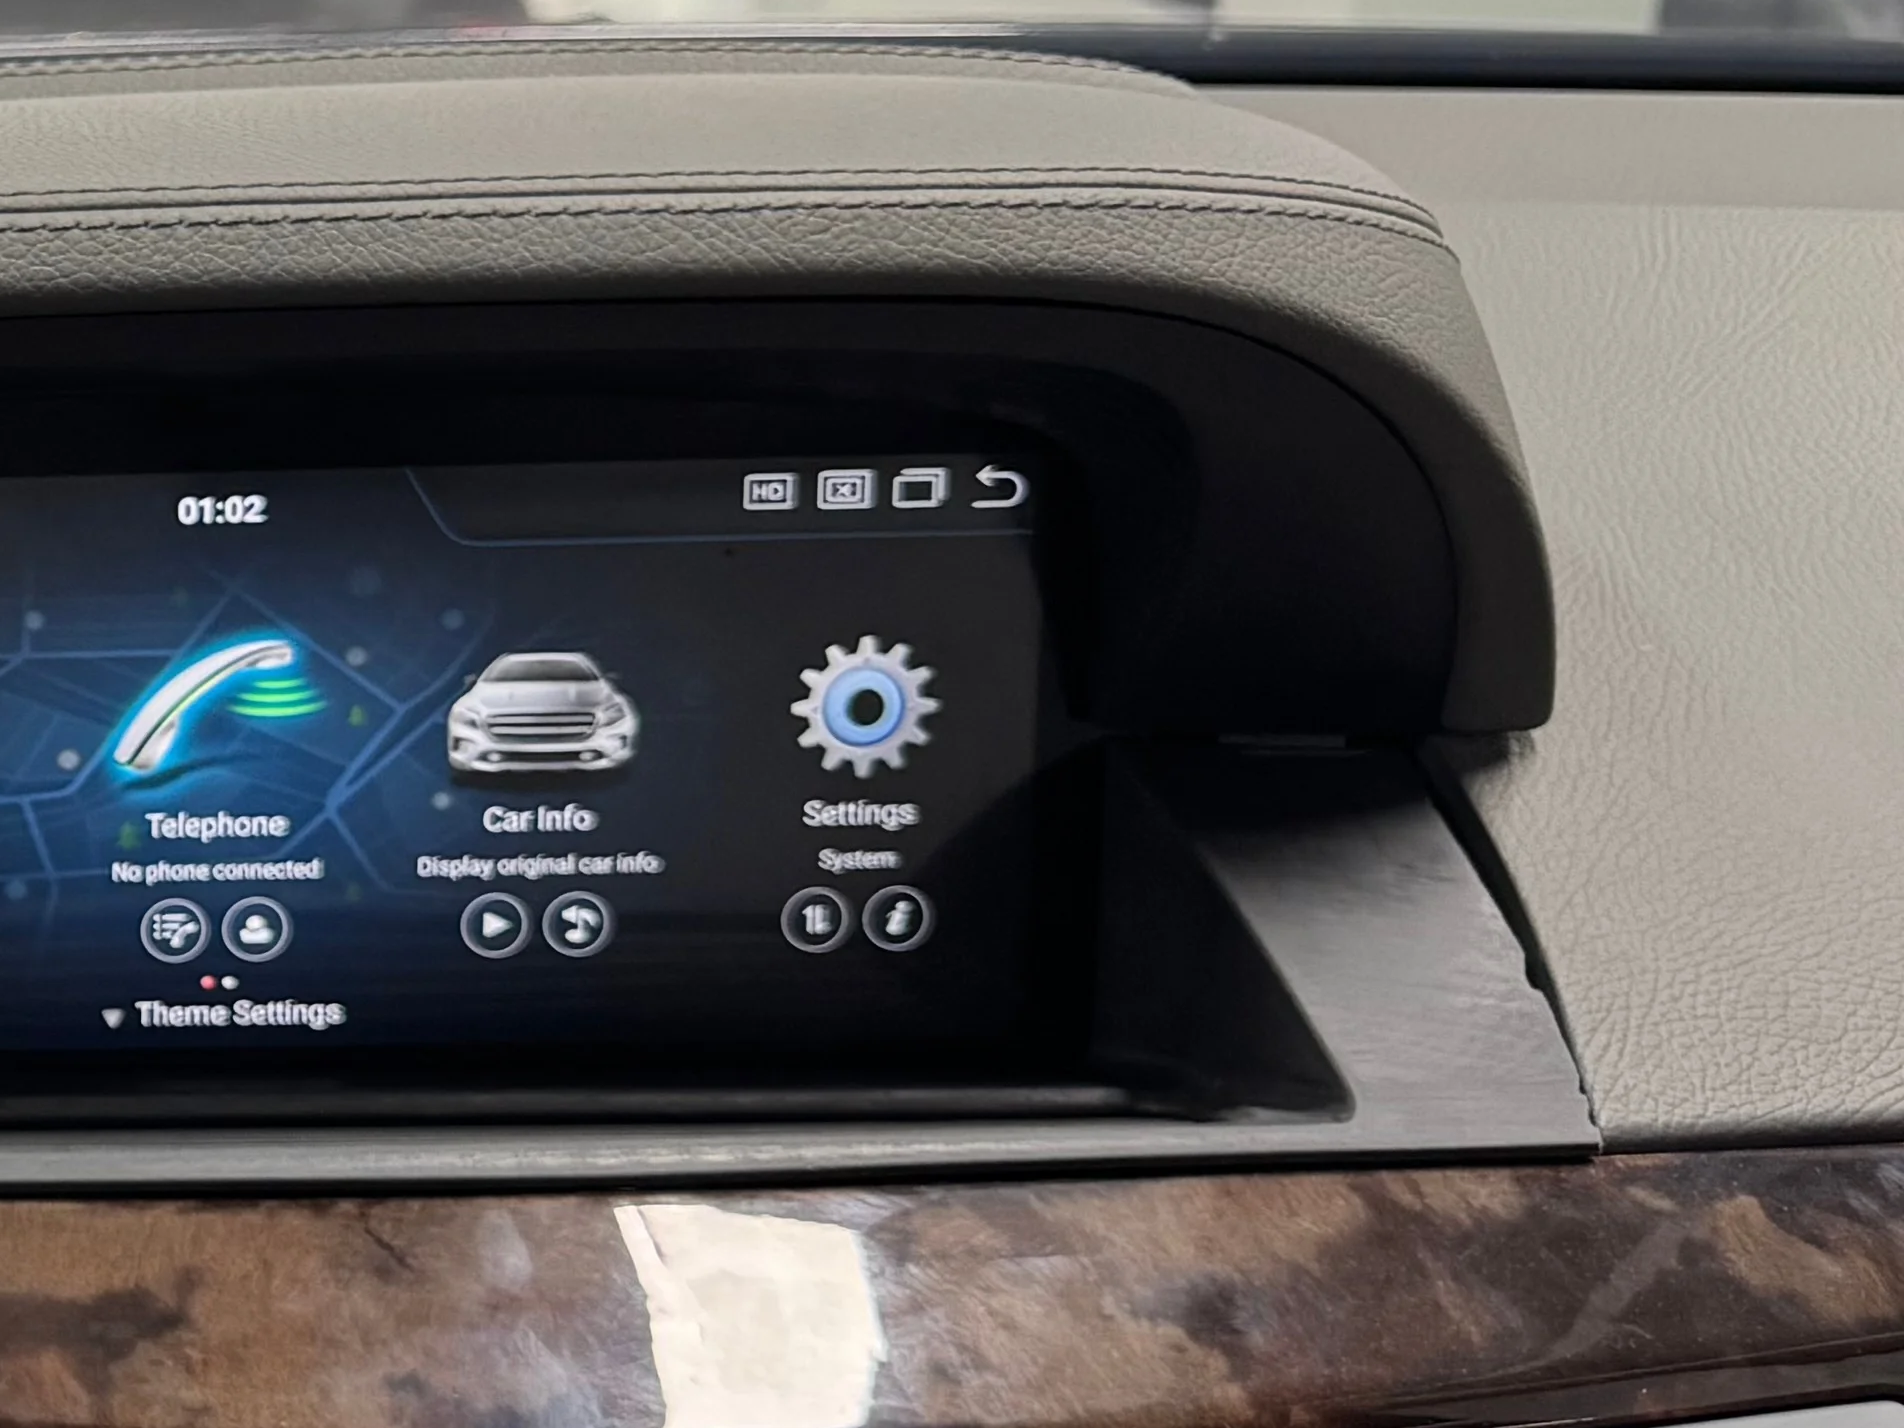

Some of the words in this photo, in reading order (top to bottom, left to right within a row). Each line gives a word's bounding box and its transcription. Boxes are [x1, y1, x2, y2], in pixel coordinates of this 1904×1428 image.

[177, 494, 269, 525] 01:02
[144, 810, 291, 844] Telephone
[482, 805, 535, 833] Car
[537, 803, 600, 832] Info
[802, 799, 922, 831] Settings
[110, 861, 142, 883] No
[145, 860, 211, 886] phone
[212, 857, 326, 881] connected
[416, 855, 496, 881] Display
[497, 853, 577, 880] original
[578, 855, 615, 875] car
[616, 850, 667, 874] info
[817, 847, 903, 875] System
[134, 999, 232, 1028] Theme
[232, 998, 348, 1031] Settings
